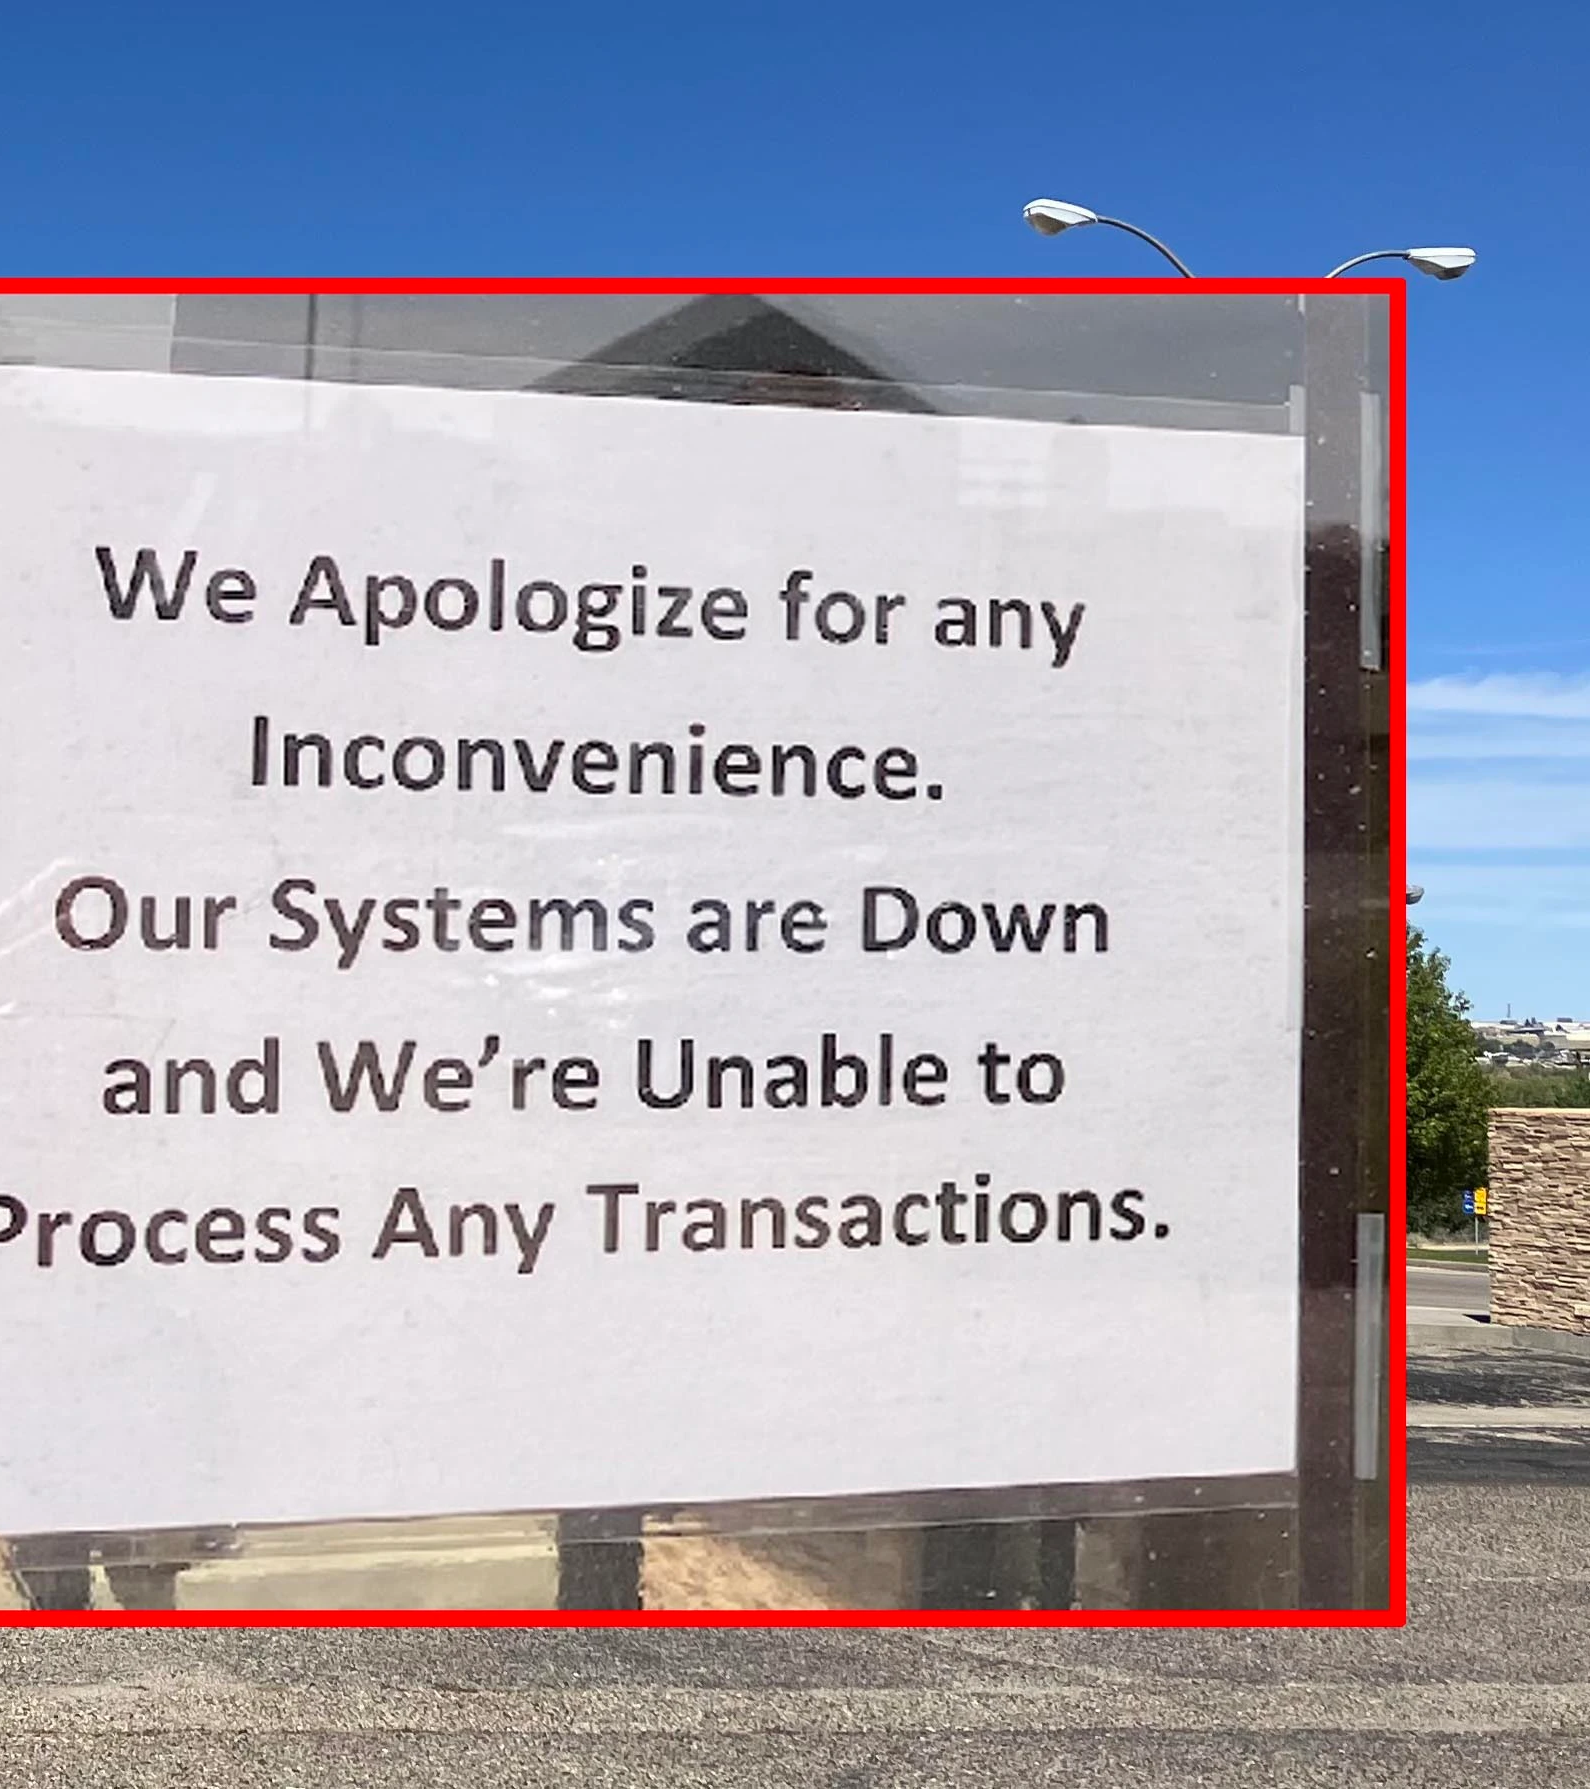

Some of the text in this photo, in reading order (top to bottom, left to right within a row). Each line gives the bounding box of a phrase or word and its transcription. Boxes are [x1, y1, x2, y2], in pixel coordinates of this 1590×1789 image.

[95, 546, 1086, 669] We Apologize for any
[252, 714, 942, 801] Inconvenience.
[54, 875, 1109, 971] Our Systems are Down
[102, 1036, 279, 1116] and
[636, 1032, 948, 1110] Unable
[977, 1041, 1066, 1106] to
[370, 1186, 555, 1275] Any
[586, 1172, 1170, 1254] Transactions.
